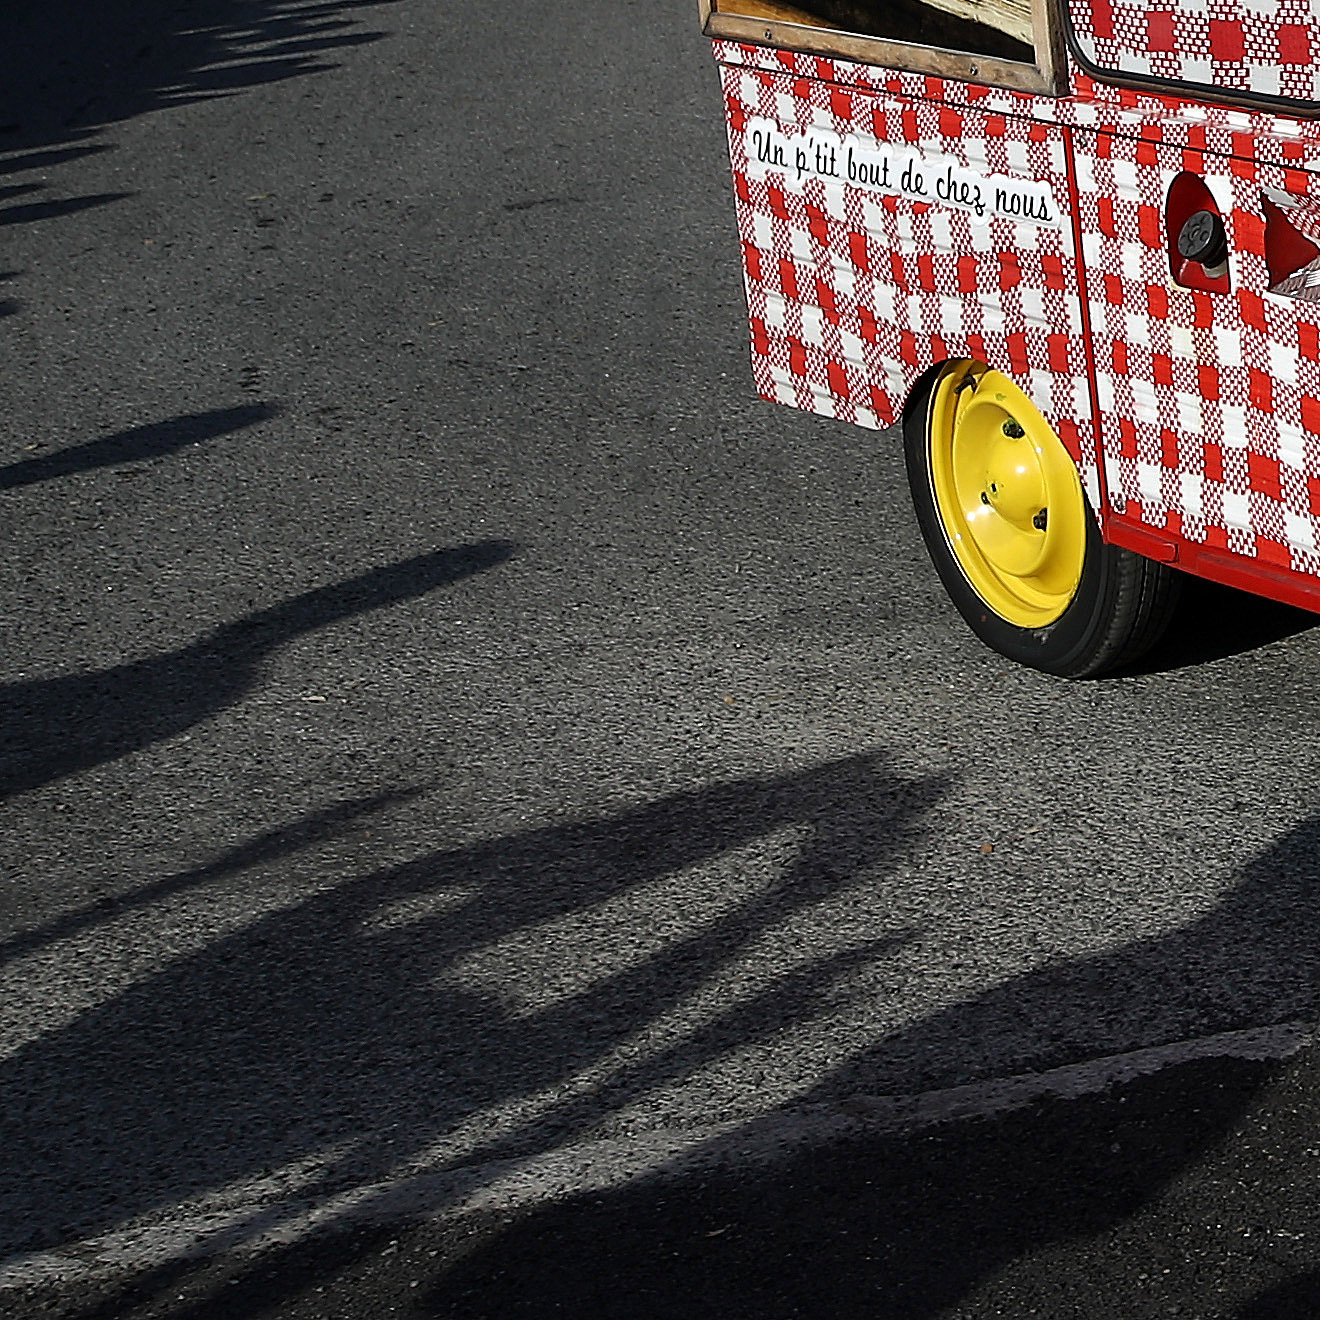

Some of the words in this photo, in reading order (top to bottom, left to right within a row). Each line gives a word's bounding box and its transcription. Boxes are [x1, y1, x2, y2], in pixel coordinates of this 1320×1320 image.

[751, 130, 788, 168] Un
[795, 137, 840, 180] p'tit
[846, 146, 893, 192] bout
[900, 154, 927, 196] de
[936, 166, 988, 218] chez
[994, 189, 1053, 223] nous
